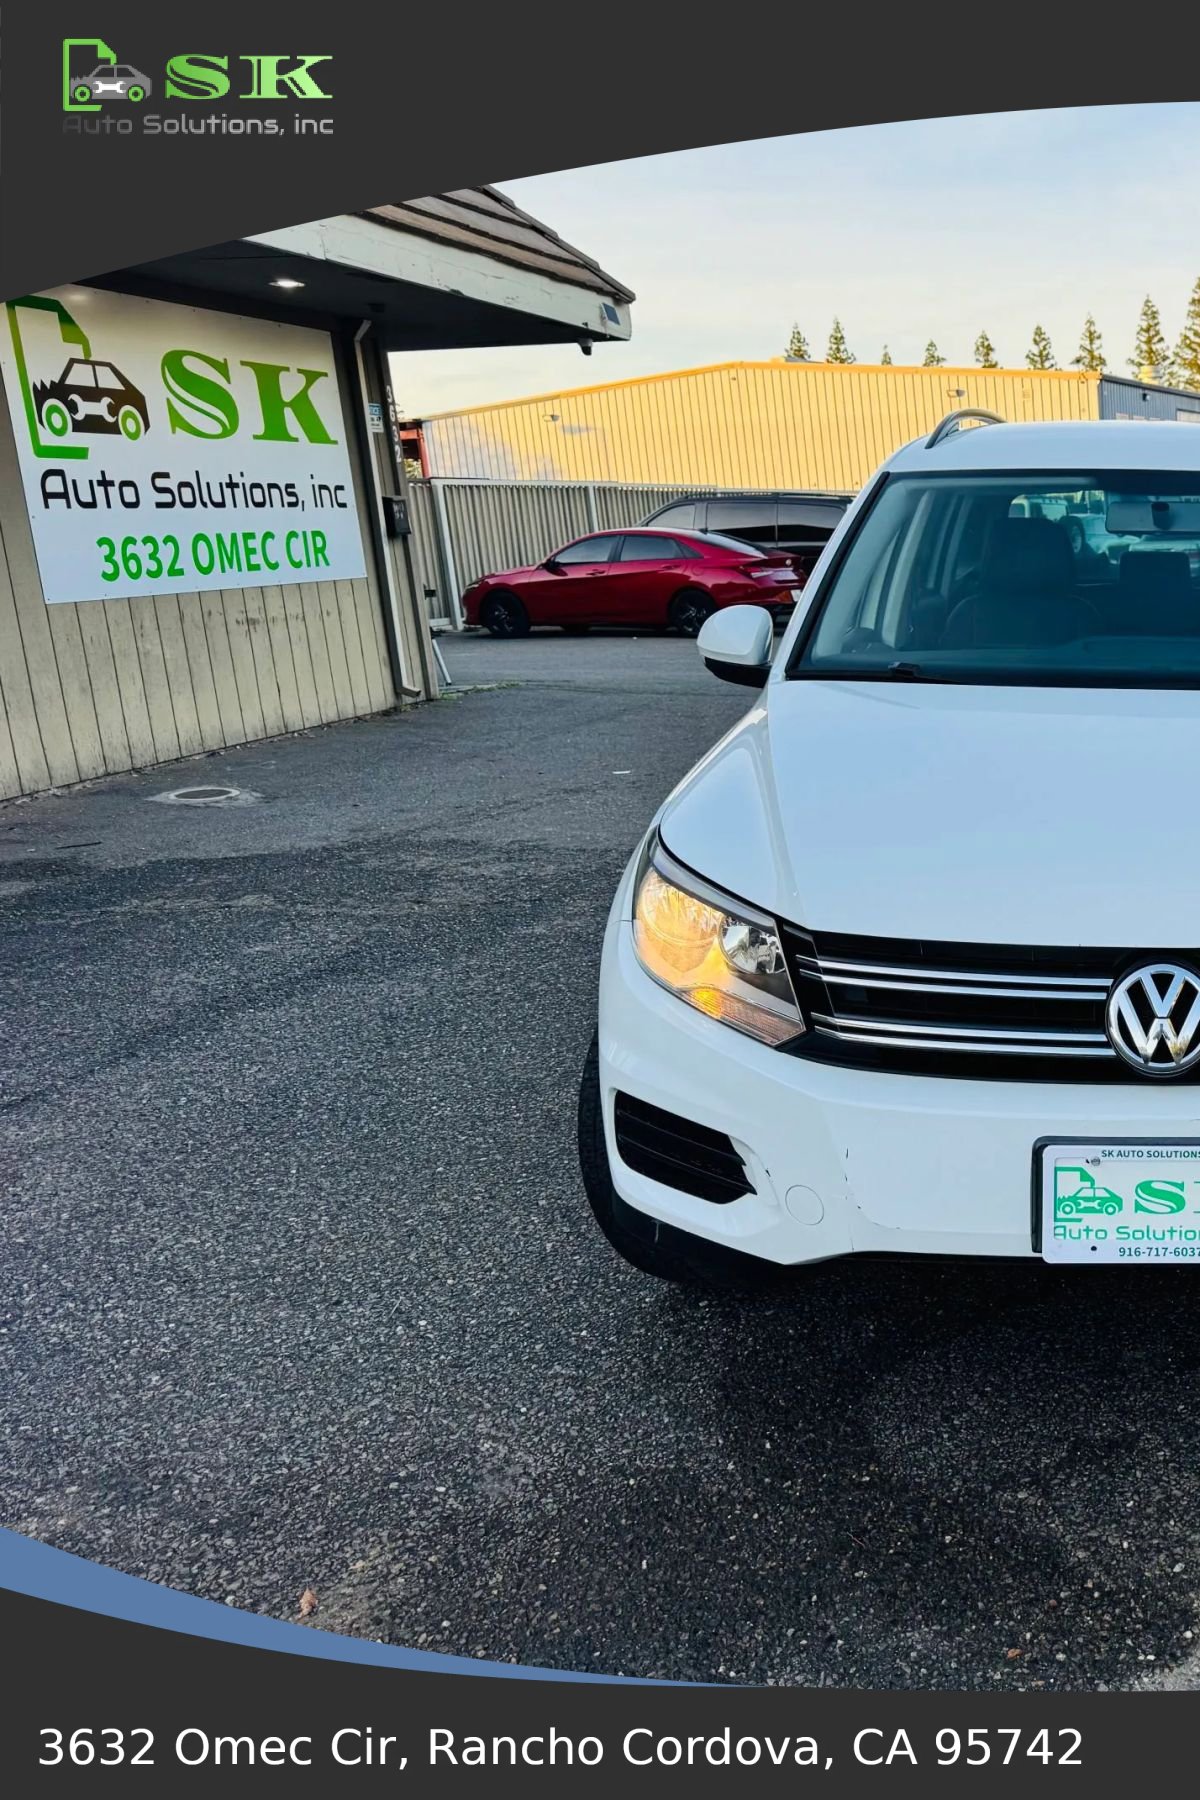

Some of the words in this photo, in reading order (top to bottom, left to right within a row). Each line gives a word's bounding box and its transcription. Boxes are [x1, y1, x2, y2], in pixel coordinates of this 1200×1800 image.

[161, 349, 338, 446] SK
[40, 468, 140, 509] Auto
[151, 470, 305, 512] Solutions,
[310, 473, 348, 508] inc
[96, 534, 185, 582] 3632
[191, 530, 280, 576] OMEC
[285, 529, 330, 568] CIR
[1101, 1150, 1114, 1158] SK
[1117, 1150, 1144, 1159] AUTO
[1054, 1225, 1108, 1240] Auto
